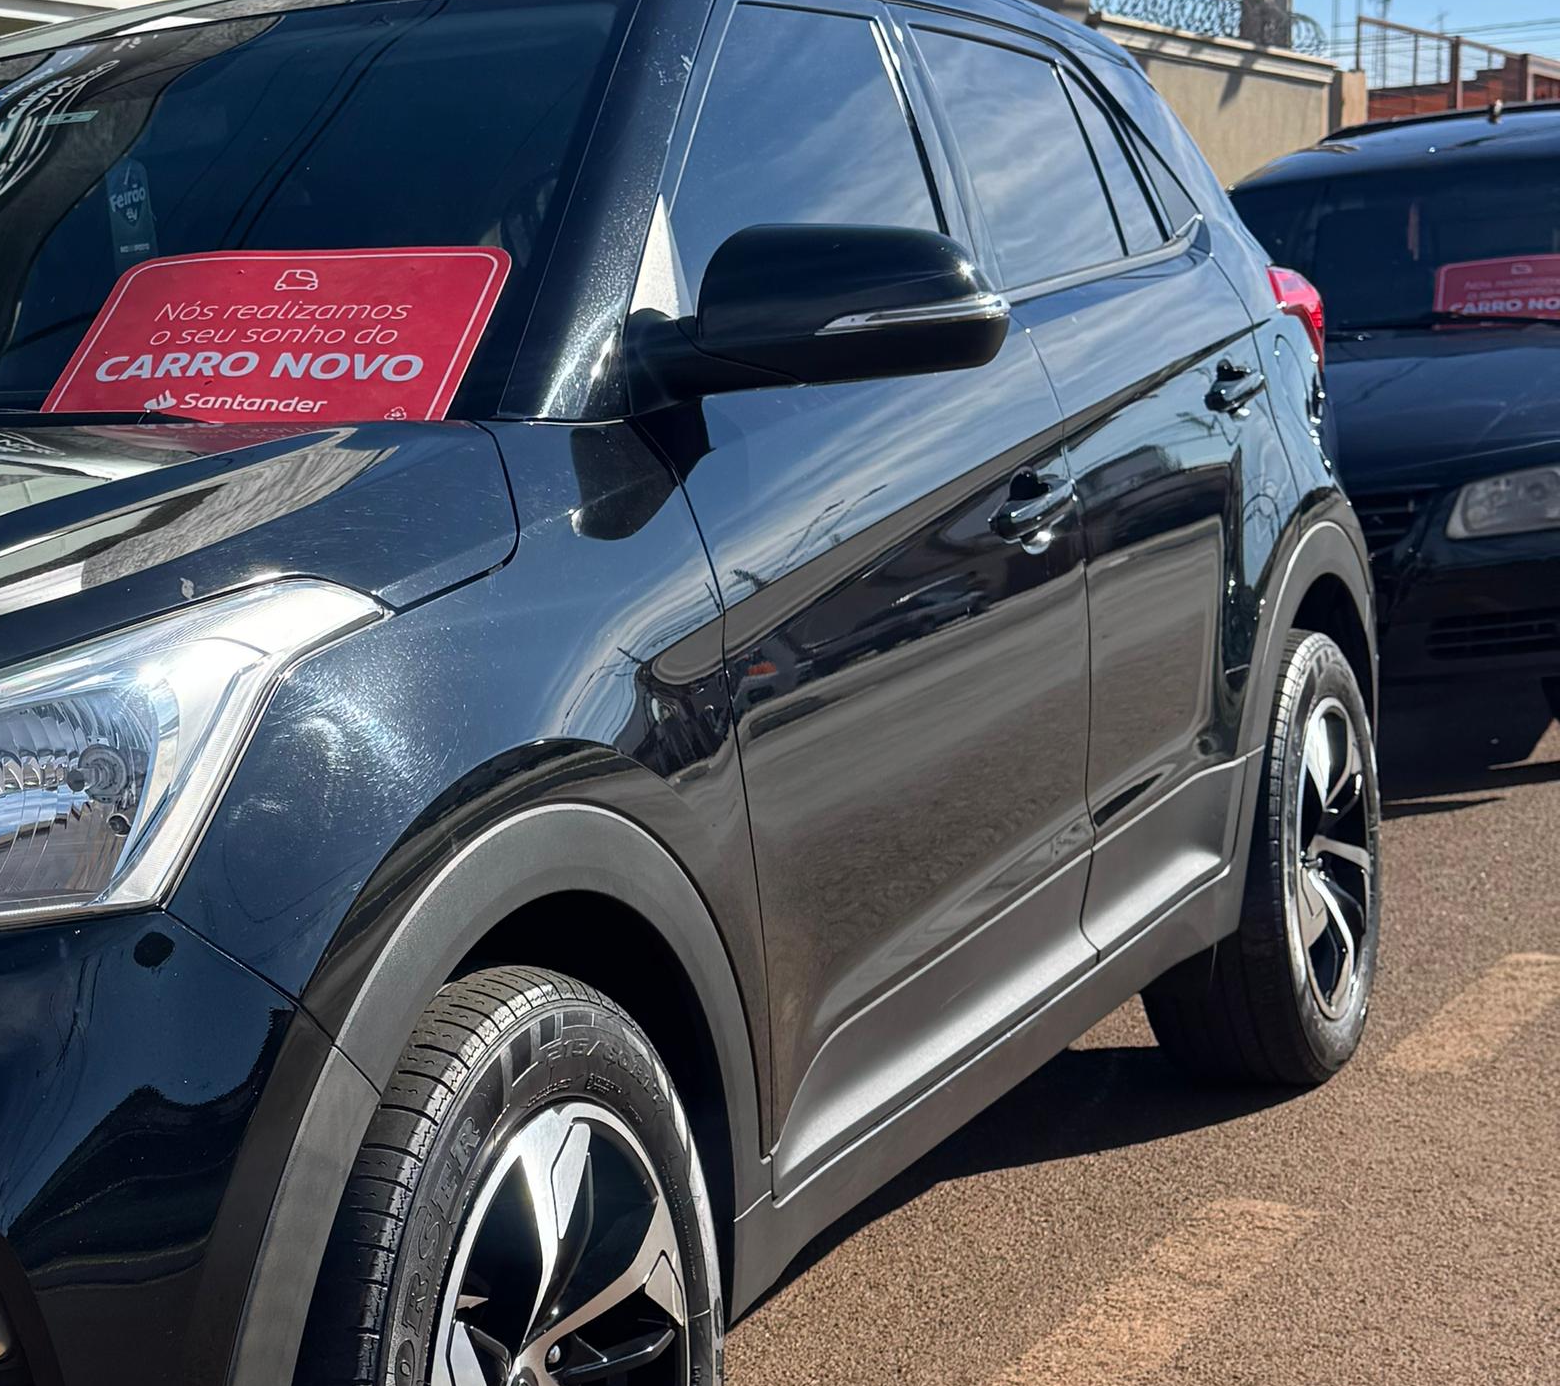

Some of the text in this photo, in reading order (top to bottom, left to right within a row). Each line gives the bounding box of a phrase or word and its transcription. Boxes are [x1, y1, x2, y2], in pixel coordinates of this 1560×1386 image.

[154, 300, 414, 322] Nós realizamos
[1449, 298, 1523, 315] CARRO
[149, 324, 399, 346] o seu sonho do
[95, 351, 424, 383] CARRO NOVO
[178, 392, 328, 414] Santander
